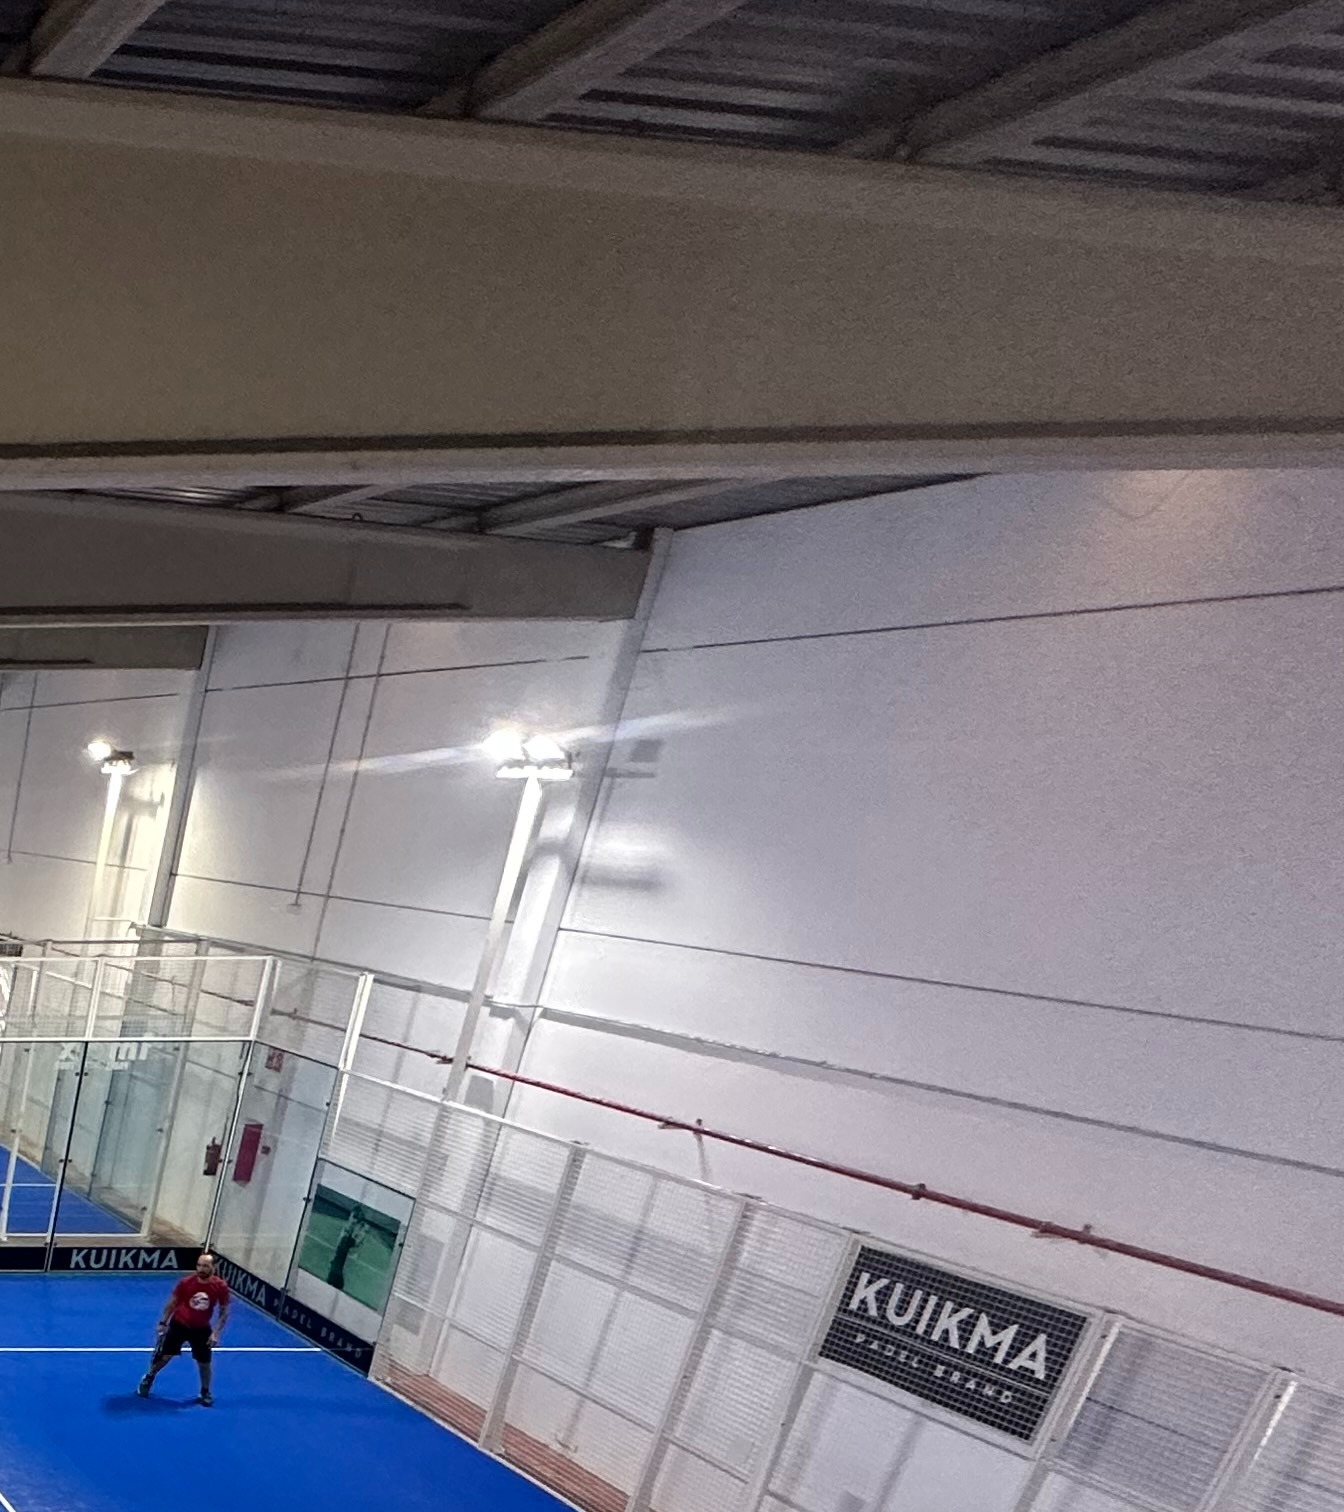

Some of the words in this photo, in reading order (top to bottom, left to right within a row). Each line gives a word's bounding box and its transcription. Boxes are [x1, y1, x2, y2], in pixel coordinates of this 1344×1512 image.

[69, 1249, 179, 1269] KUIKMA
[213, 1257, 267, 1307] KUIKMA
[848, 1271, 1048, 1380] KUIKMA
[855, 1333, 921, 1368] PADEL
[933, 1364, 1013, 1404] BRAND
